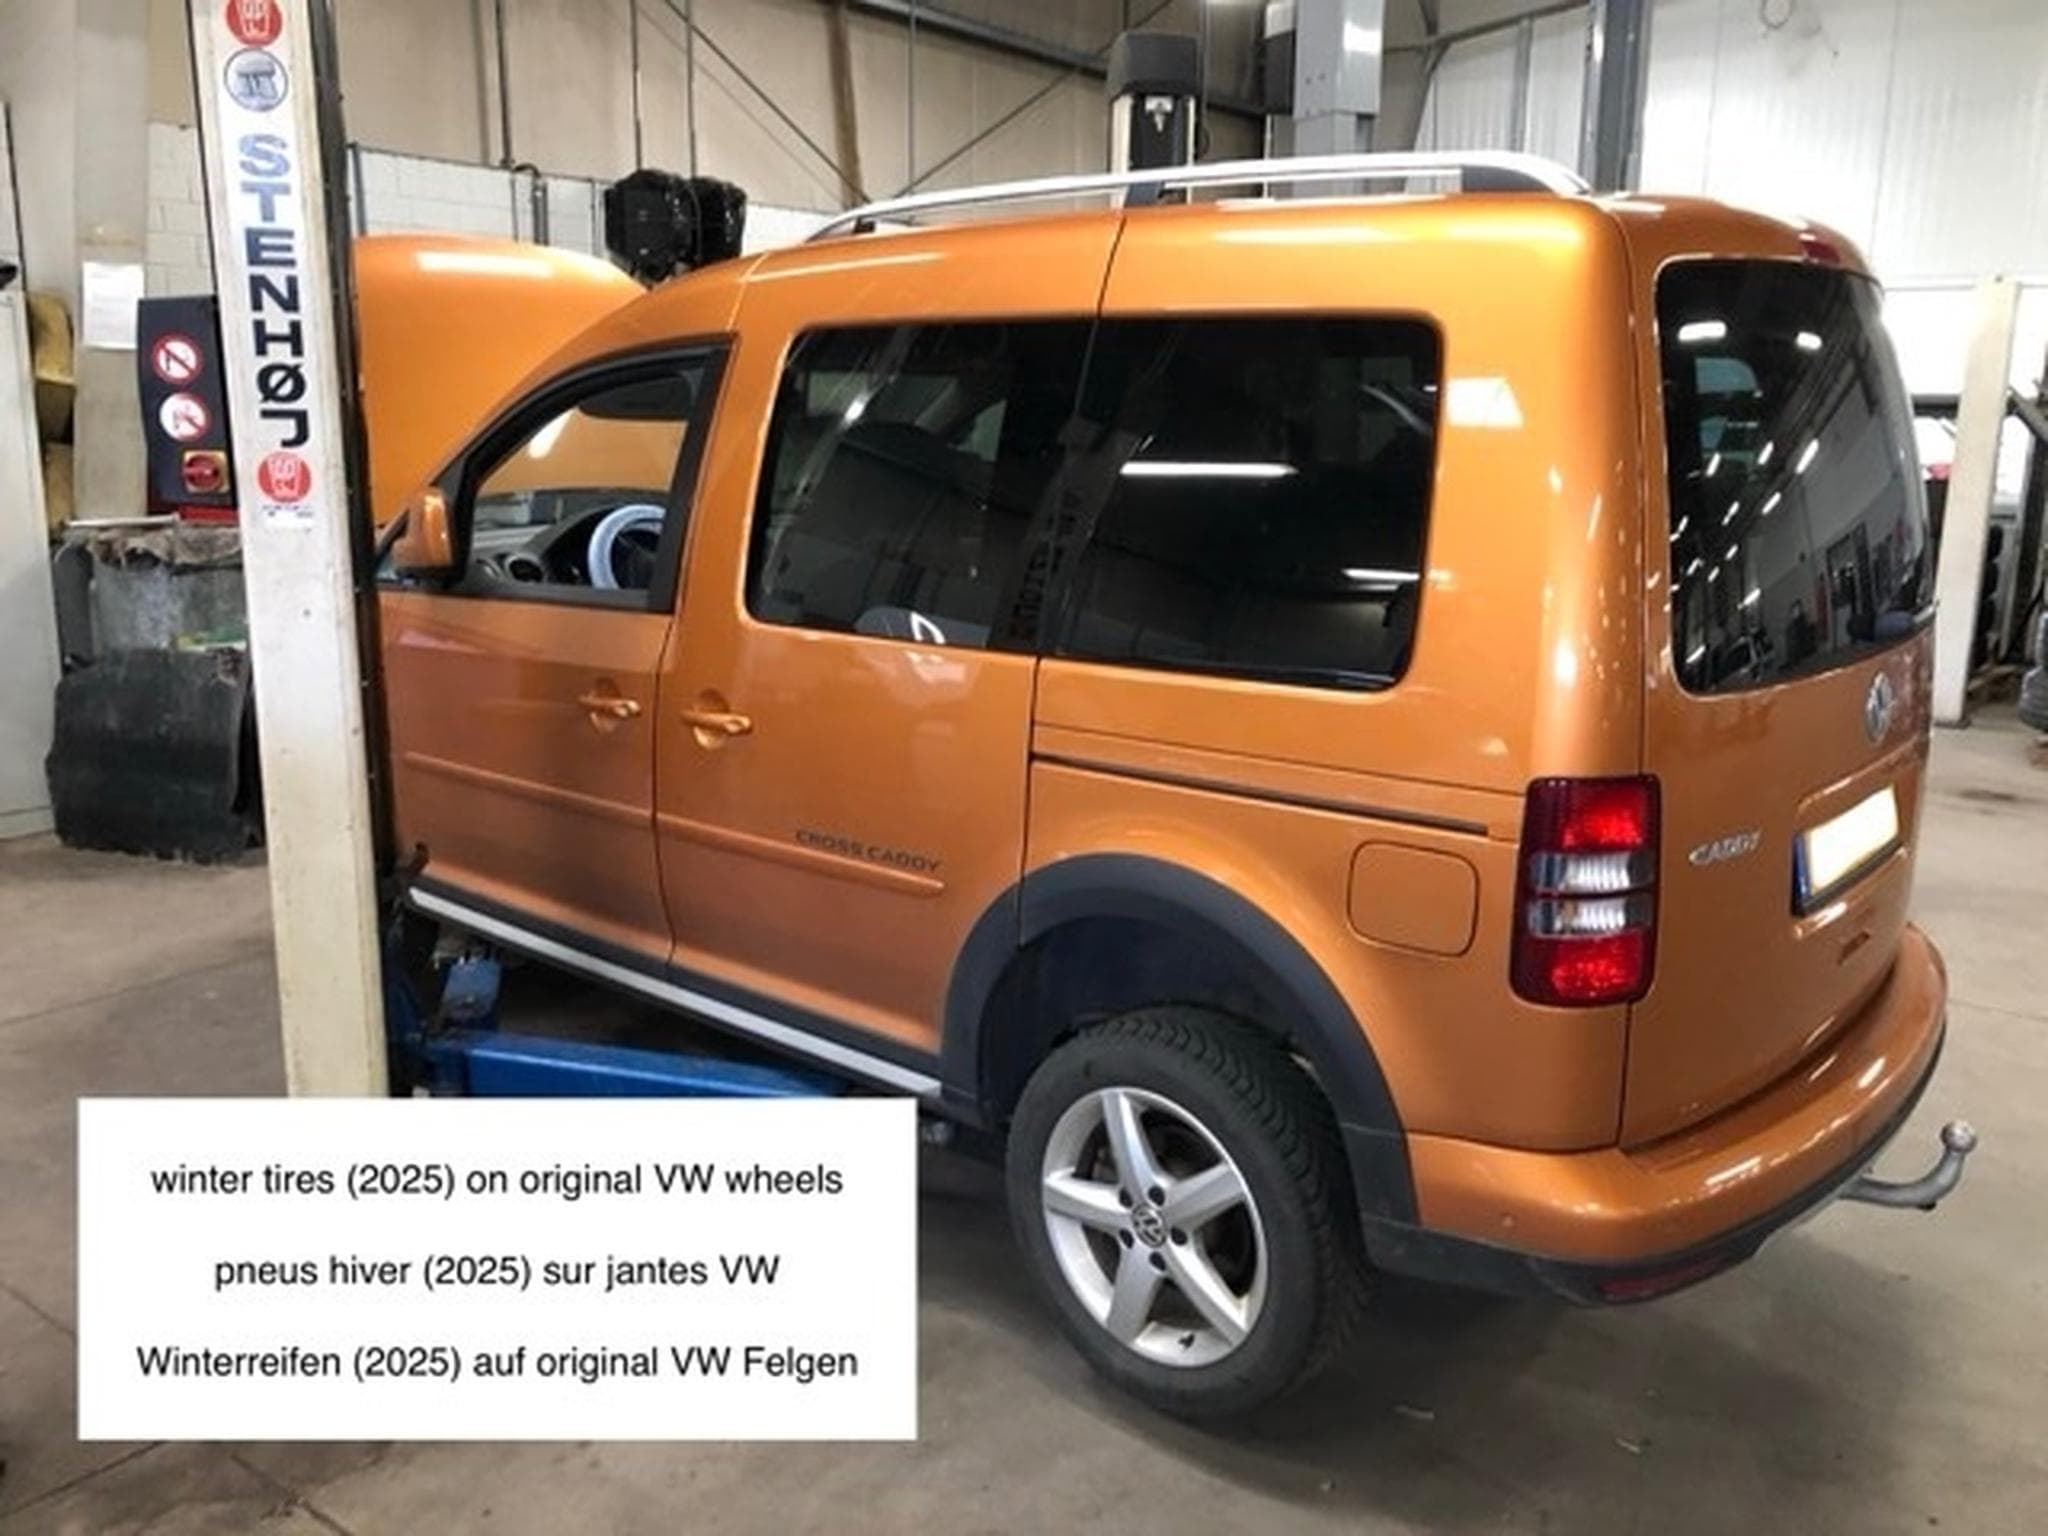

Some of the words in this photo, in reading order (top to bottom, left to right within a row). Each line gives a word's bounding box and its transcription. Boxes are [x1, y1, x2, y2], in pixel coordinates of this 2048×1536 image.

[239, 133, 310, 449] STENHØJ
[796, 829, 864, 857] CROSS
[866, 845, 942, 873] CADDY
[1688, 829, 1763, 866] CADDY
